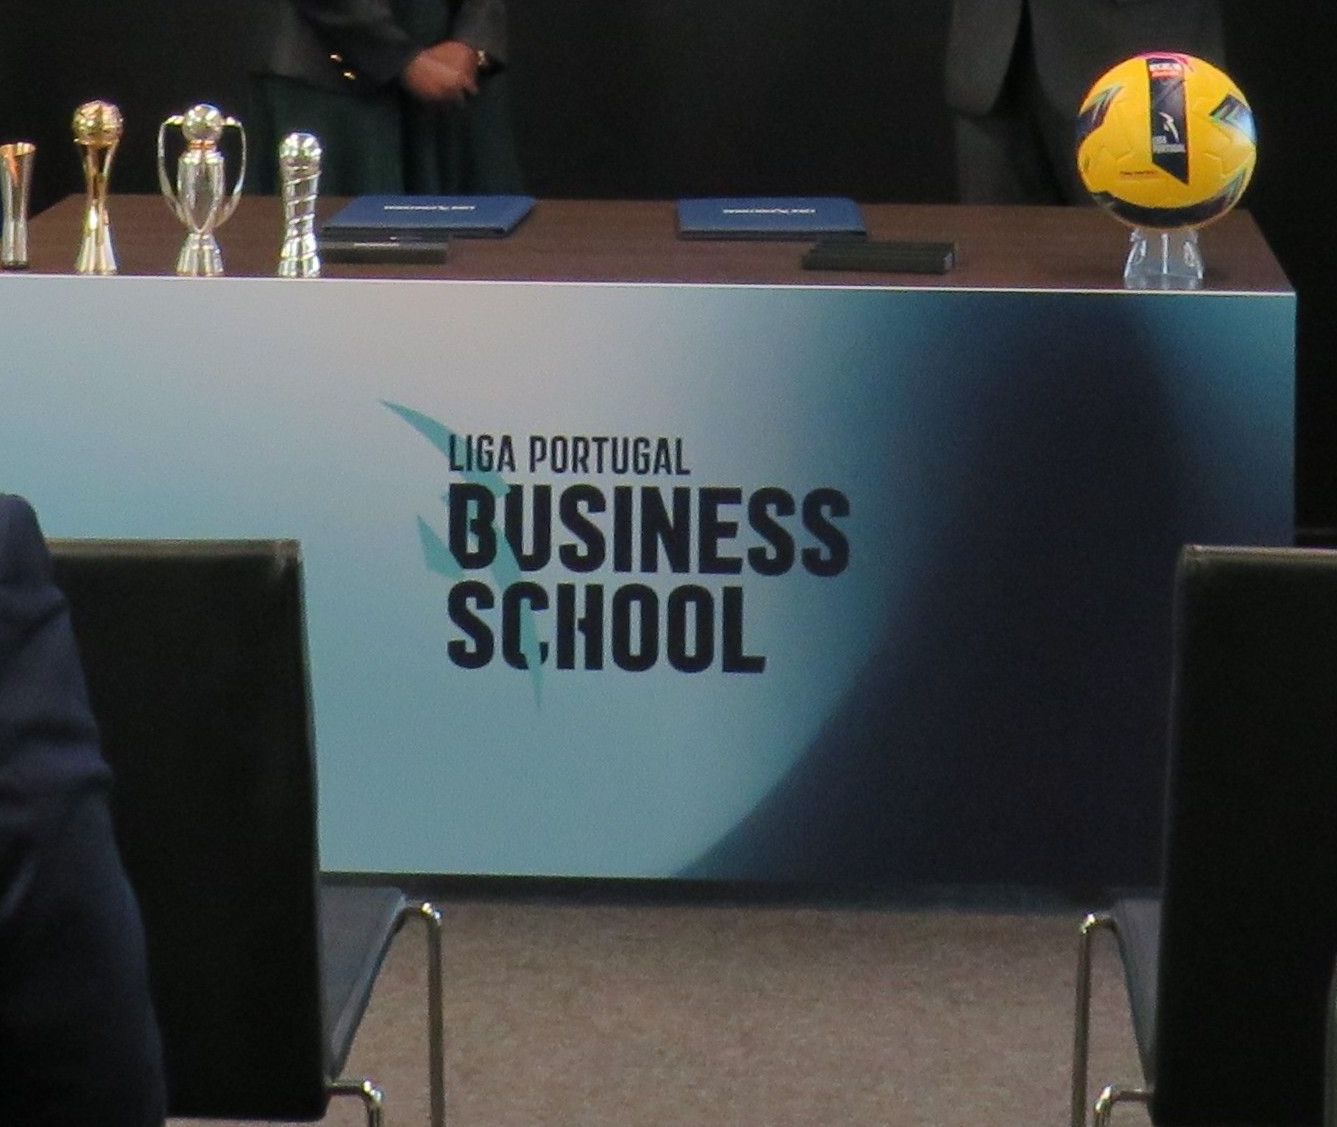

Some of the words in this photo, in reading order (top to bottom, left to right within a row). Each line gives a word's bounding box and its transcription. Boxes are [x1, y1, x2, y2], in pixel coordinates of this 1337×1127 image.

[448, 433, 517, 473] LIGA
[529, 434, 692, 476] PORTUGAL
[448, 482, 851, 577] BUSINESS
[447, 580, 768, 674] SCHOOL
